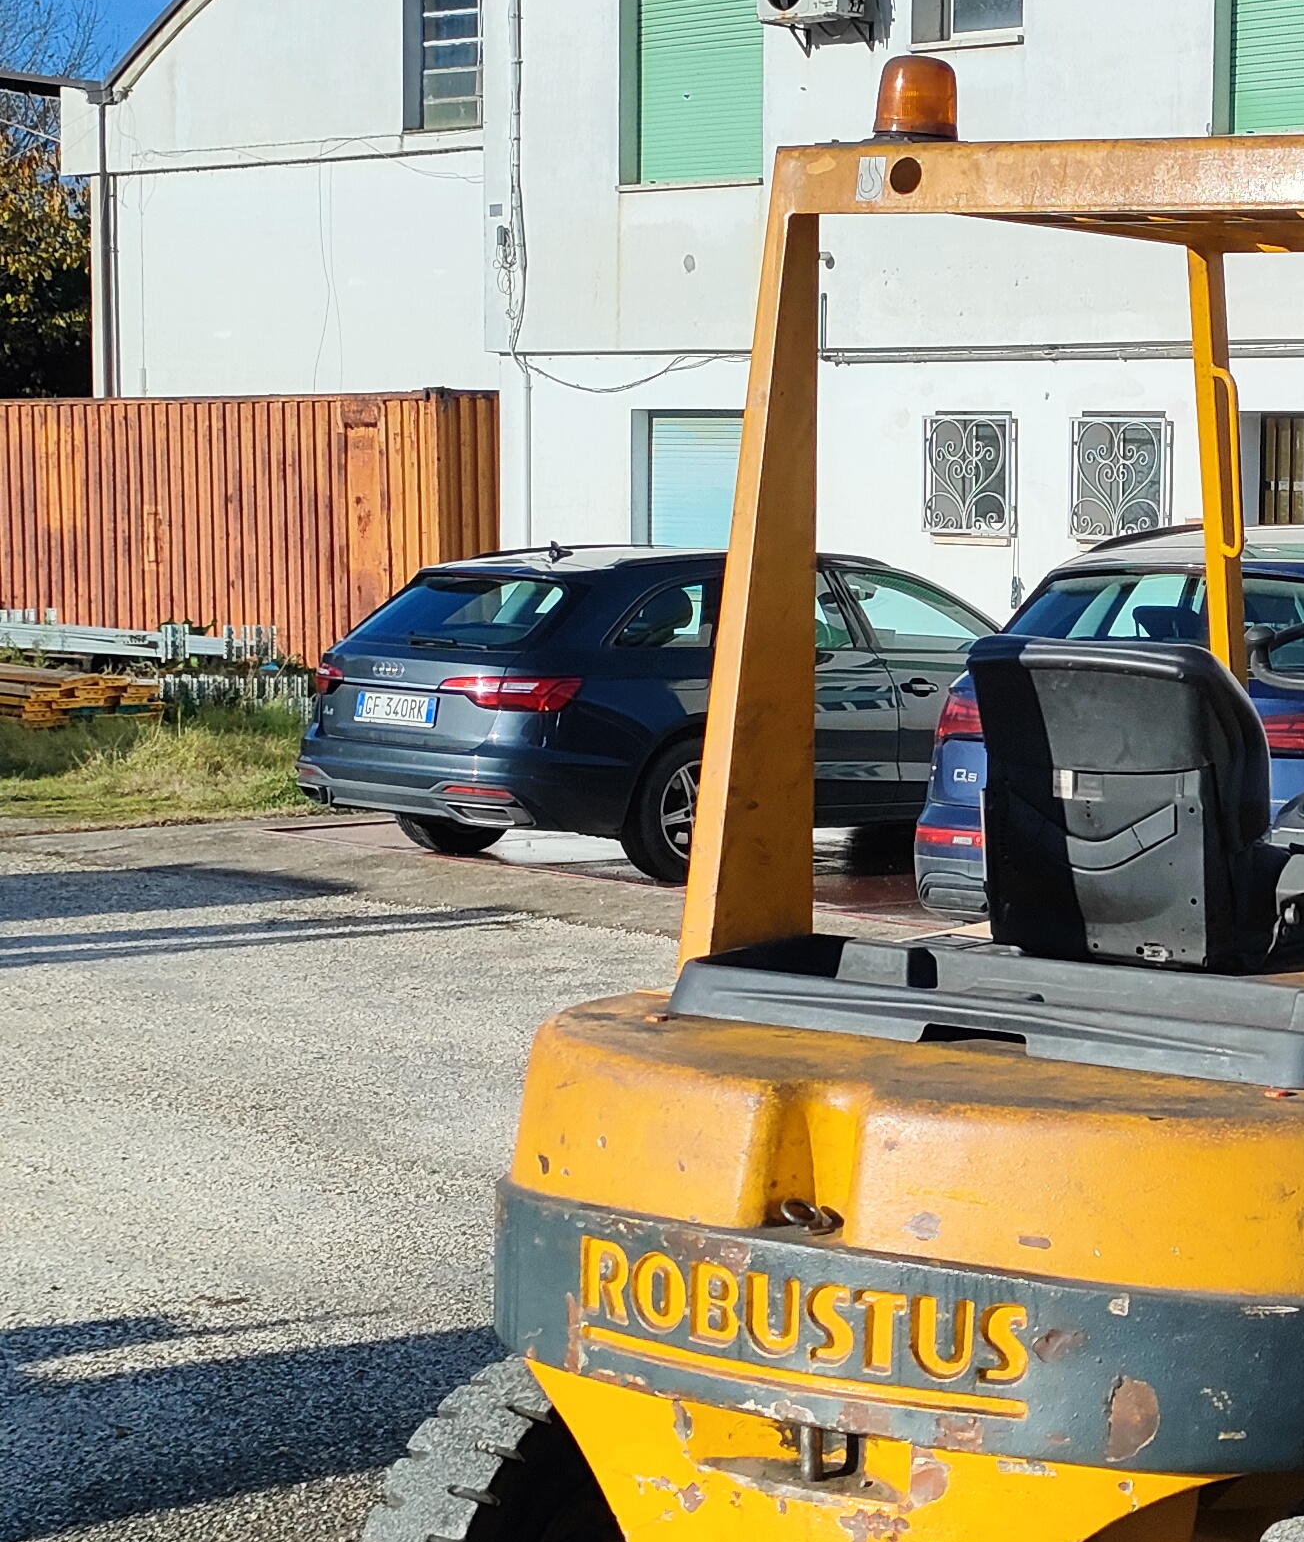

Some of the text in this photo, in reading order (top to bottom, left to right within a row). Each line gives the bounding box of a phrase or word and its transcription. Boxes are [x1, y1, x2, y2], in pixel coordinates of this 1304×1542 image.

[365, 695, 426, 720] GF 340RK
[953, 768, 978, 783] Q5
[580, 1234, 1029, 1386] ROBUSTUS
